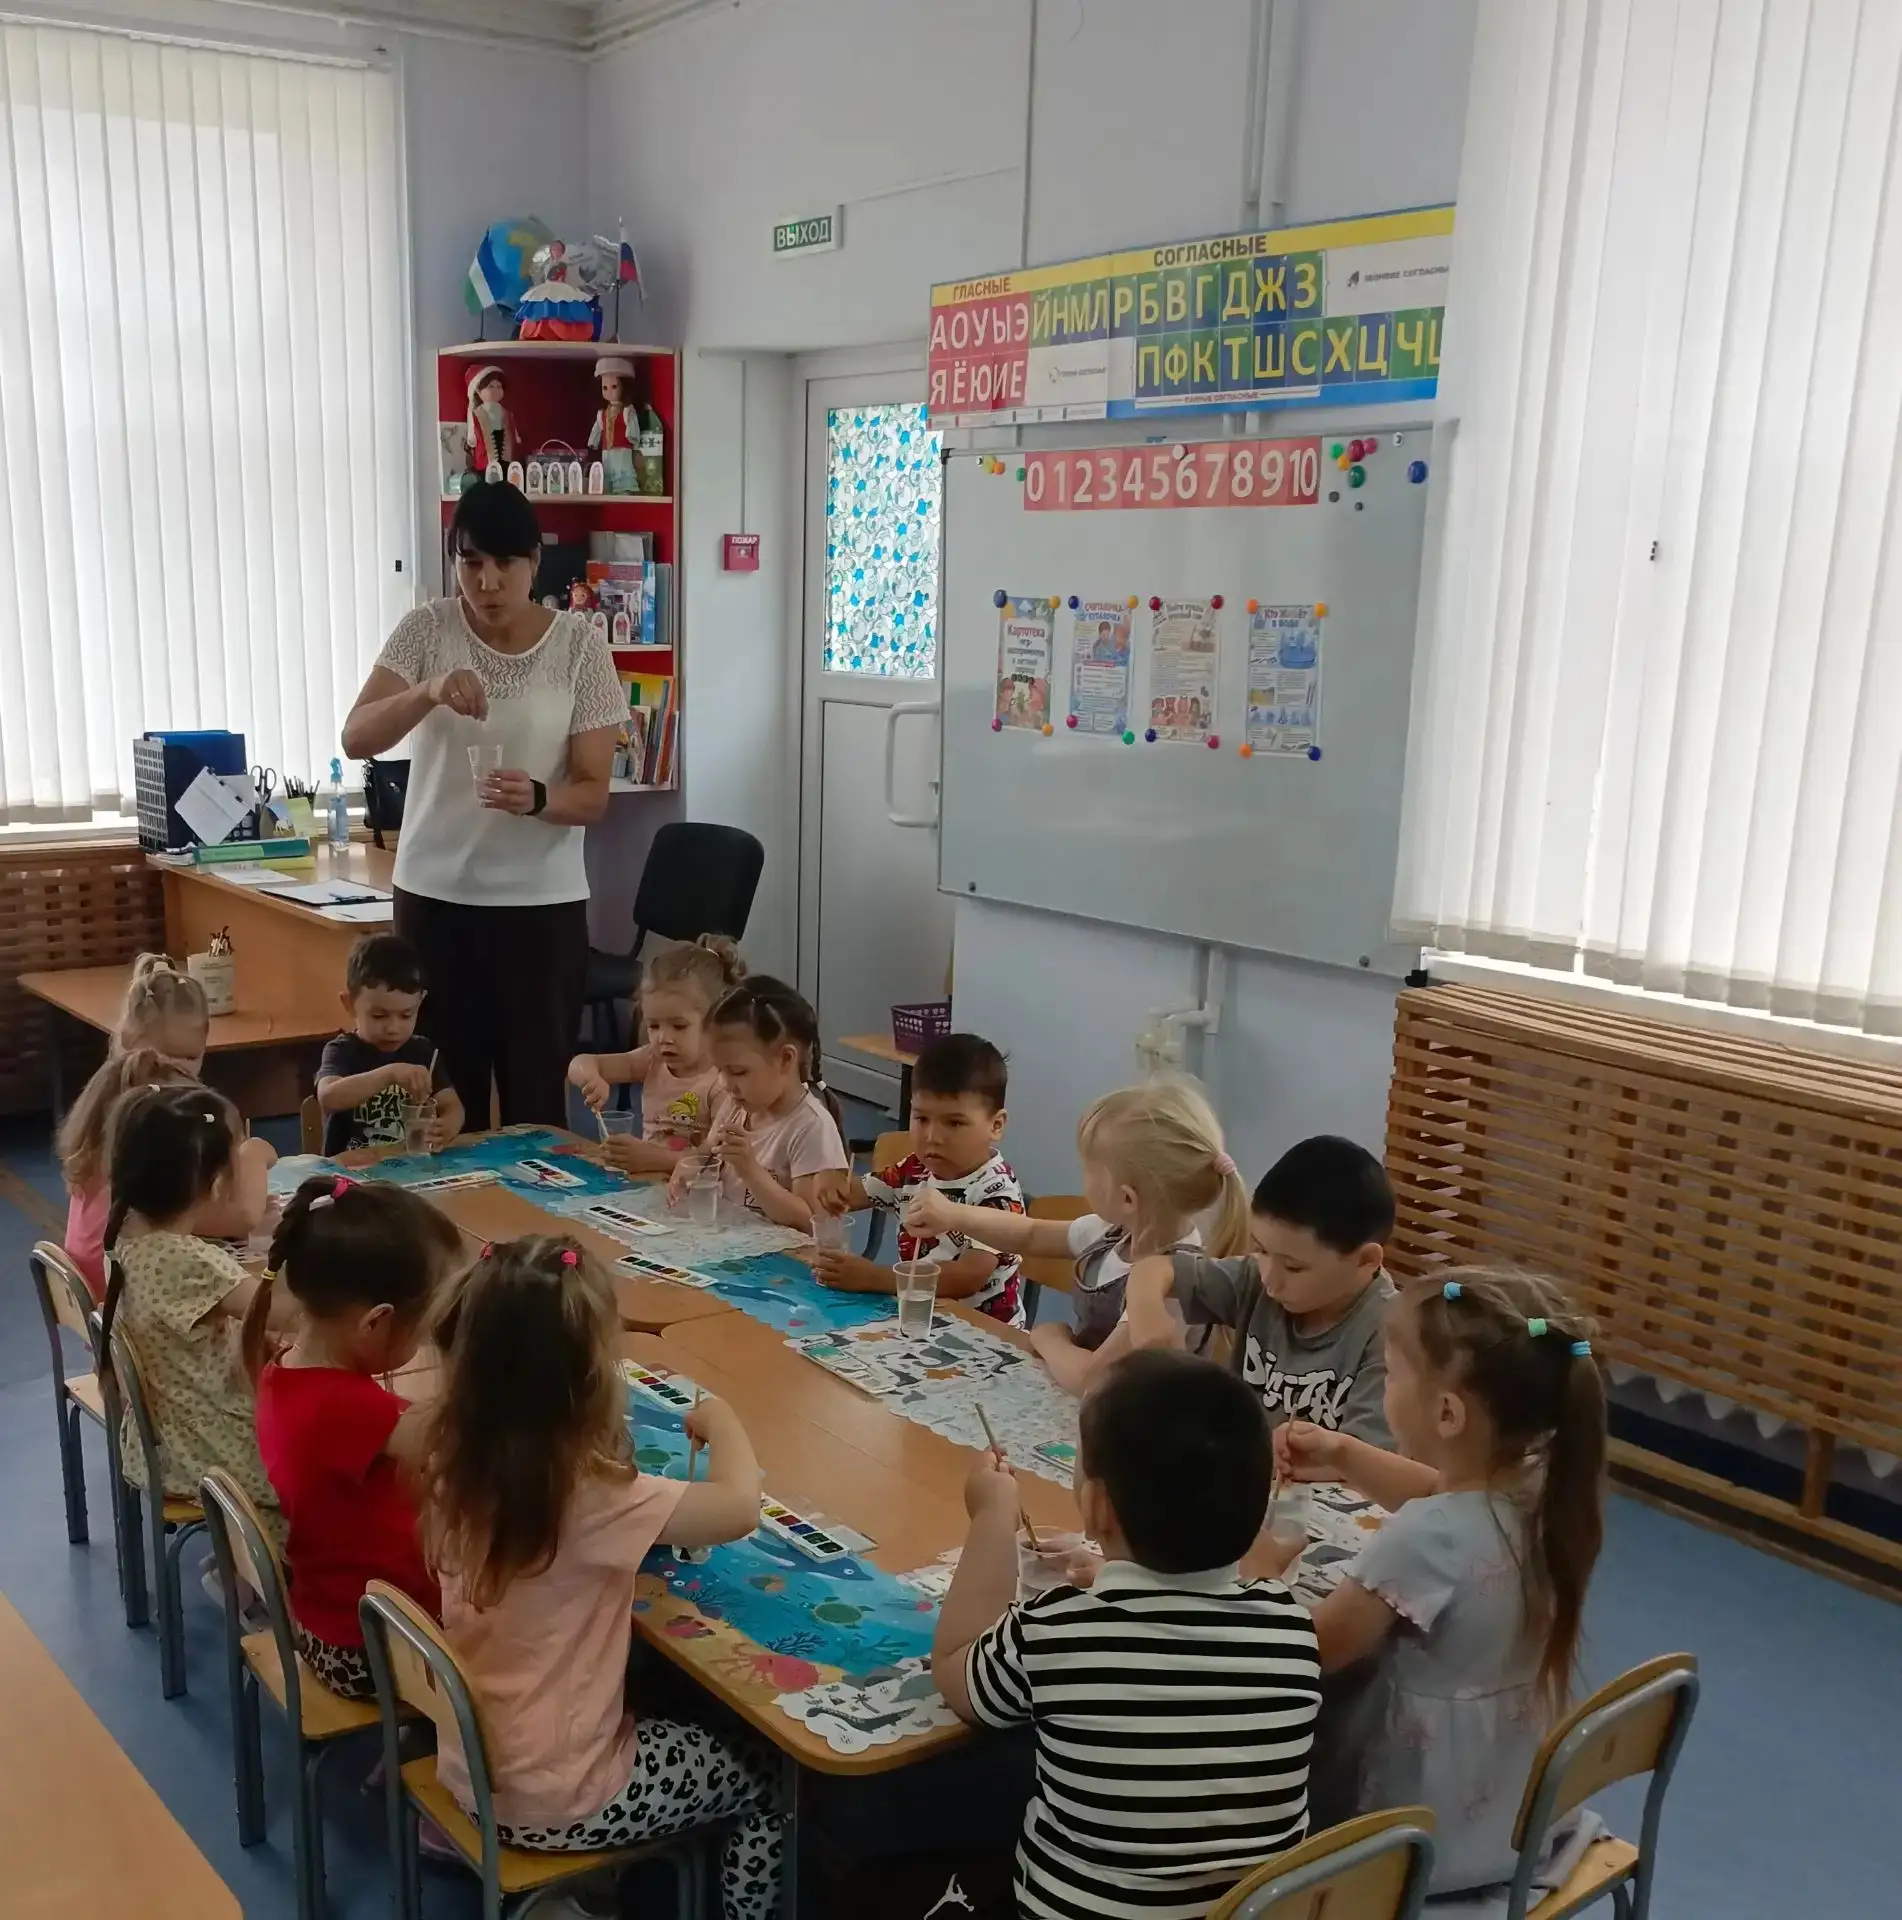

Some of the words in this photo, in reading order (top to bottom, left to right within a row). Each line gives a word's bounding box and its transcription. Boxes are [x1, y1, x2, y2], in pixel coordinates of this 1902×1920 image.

[776, 219, 829, 248] ВЫХОД
[1153, 235, 1267, 267] СОГЛАСНЫЕ
[953, 276, 1011, 301] ГЛАСНЫЕ
[731, 536, 758, 545] ПОЖАР
